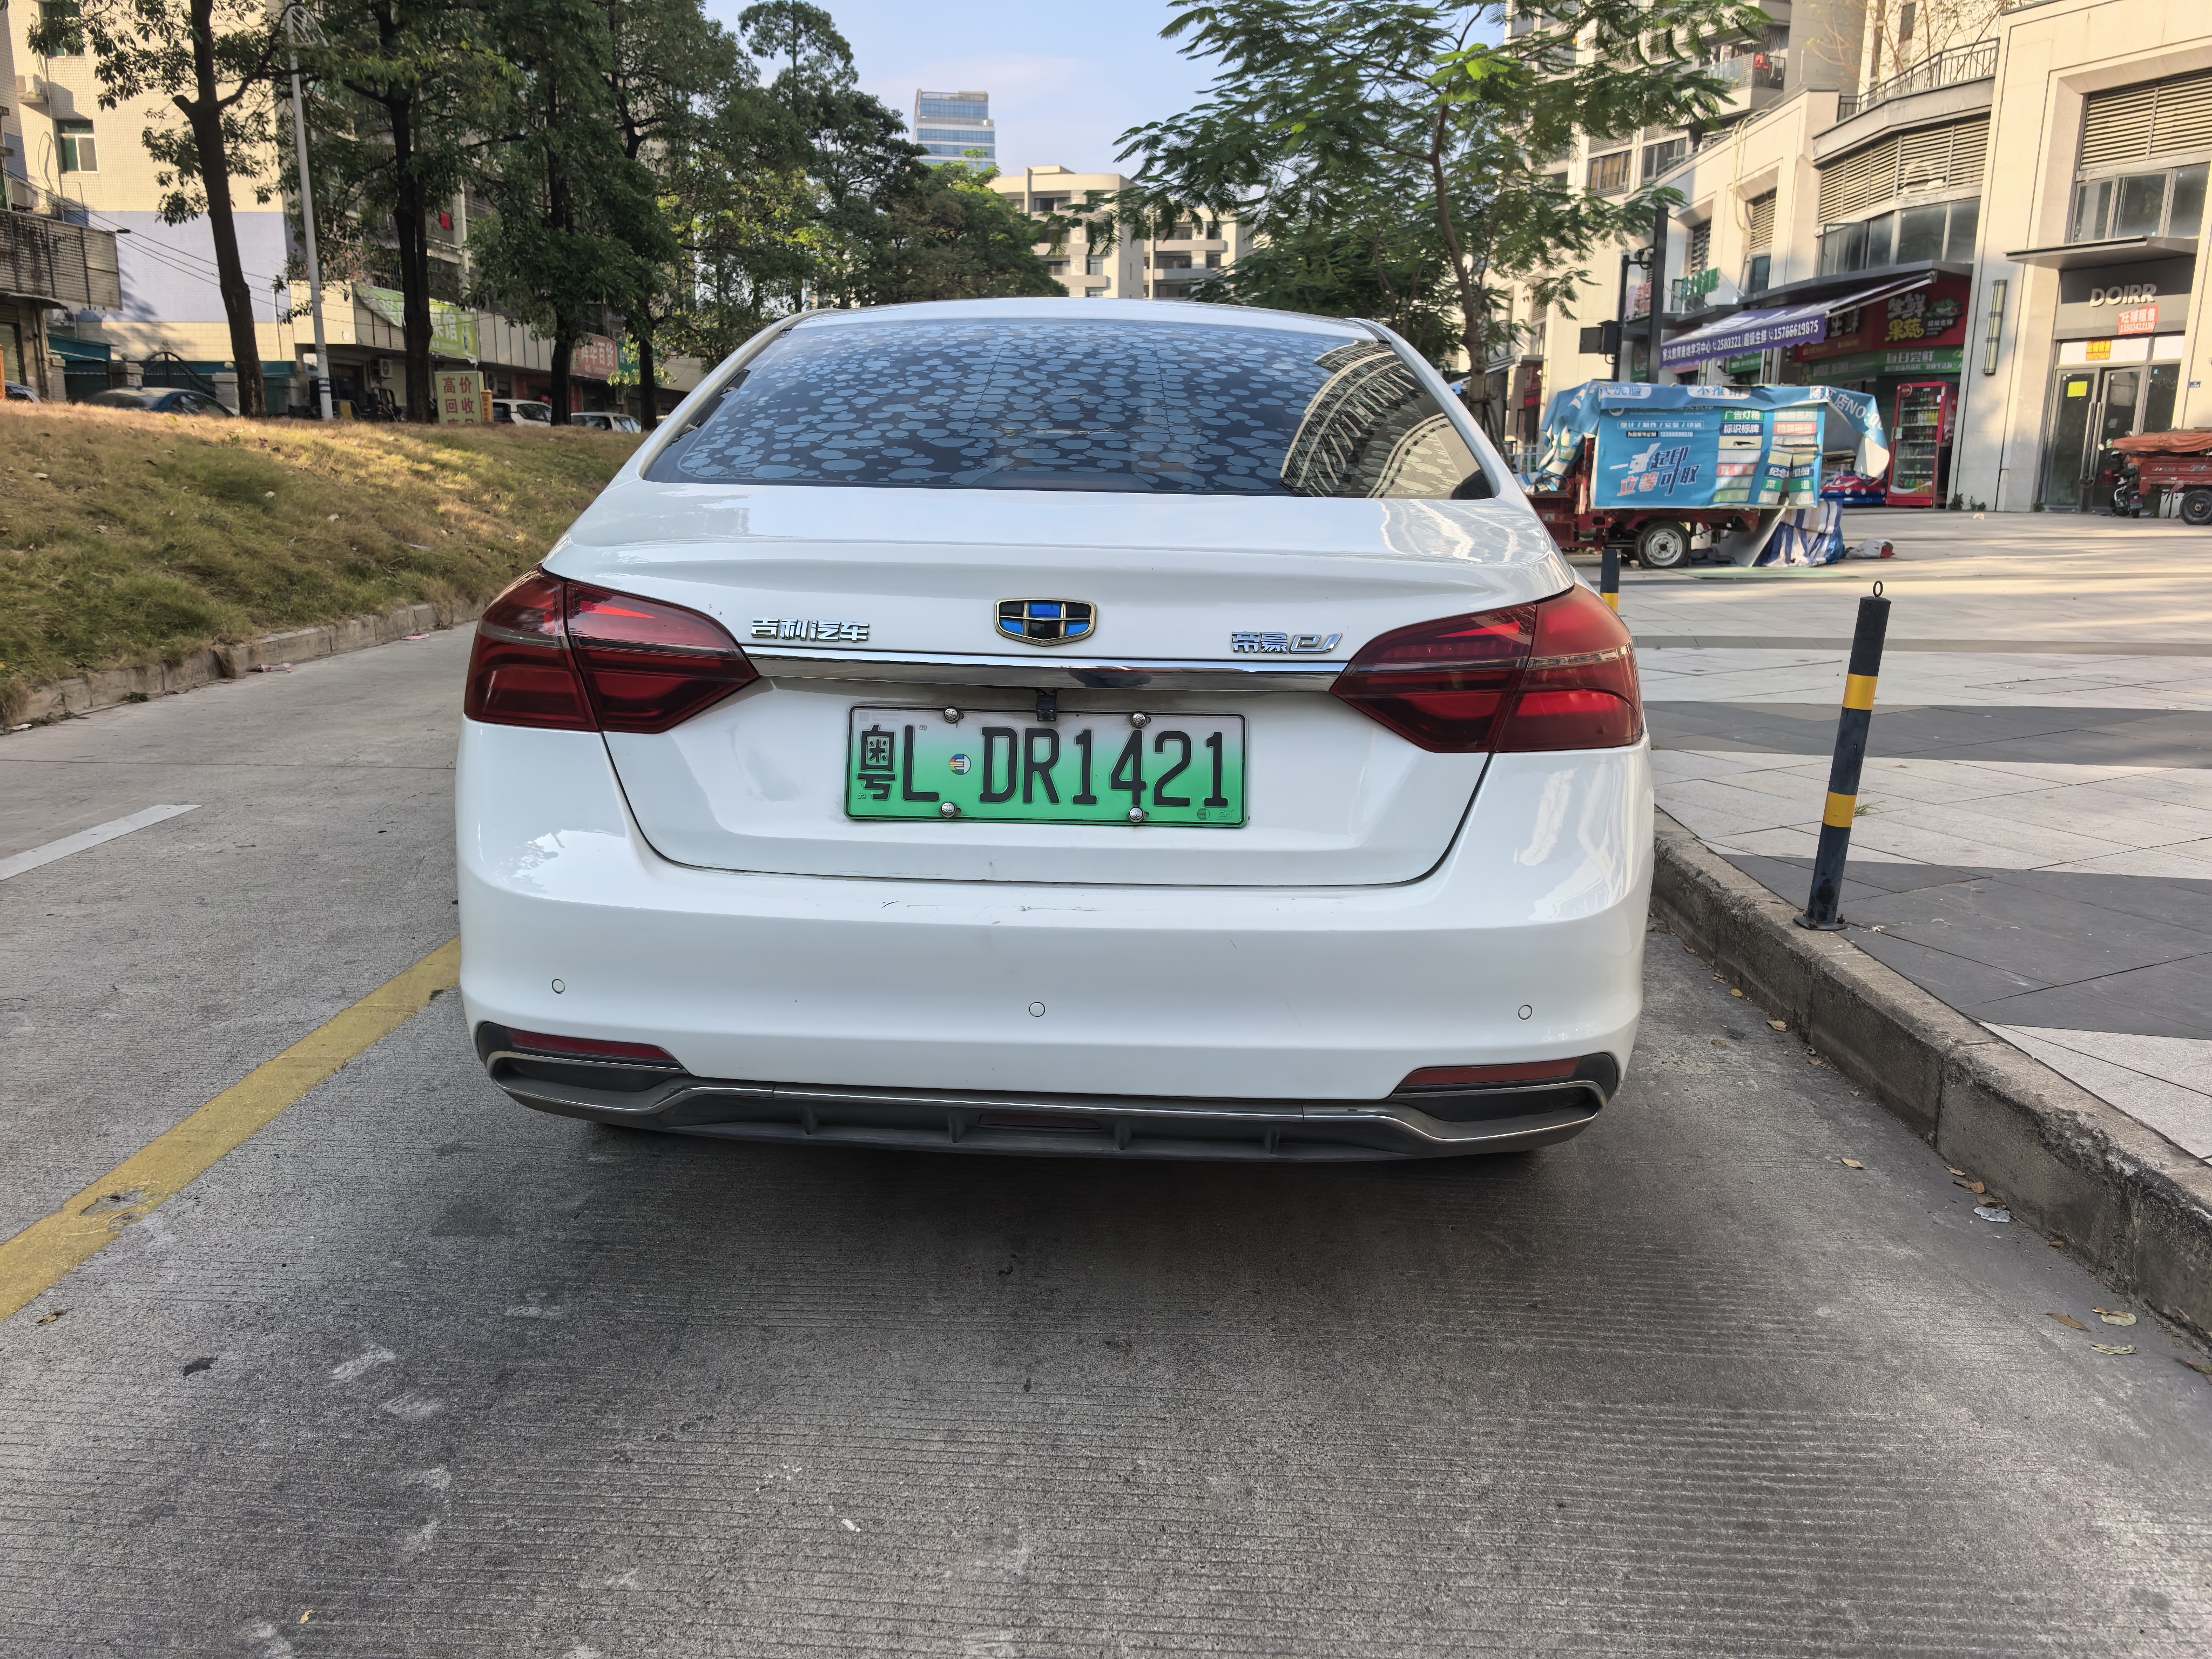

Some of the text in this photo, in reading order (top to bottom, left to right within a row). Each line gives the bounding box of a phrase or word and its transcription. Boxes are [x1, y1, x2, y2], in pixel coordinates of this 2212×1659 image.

[1887, 293, 1926, 319] 生鲜
[2089, 284, 2156, 307] DOIRR
[1717, 335, 1741, 350] 2580321
[1774, 320, 1819, 340] 15766619875
[1885, 318, 1924, 341] 果蔬
[442, 376, 472, 394] 高价
[445, 397, 475, 414] 回收
[1724, 410, 1760, 420] 广告灯箱
[1723, 423, 1759, 434] 标识标牌
[1616, 463, 1701, 497] 立等可取
[751, 617, 870, 643] 吉利汽车
[1232, 631, 1287, 653] 帝豪
[857, 724, 1229, 807] 粤L DR1421
